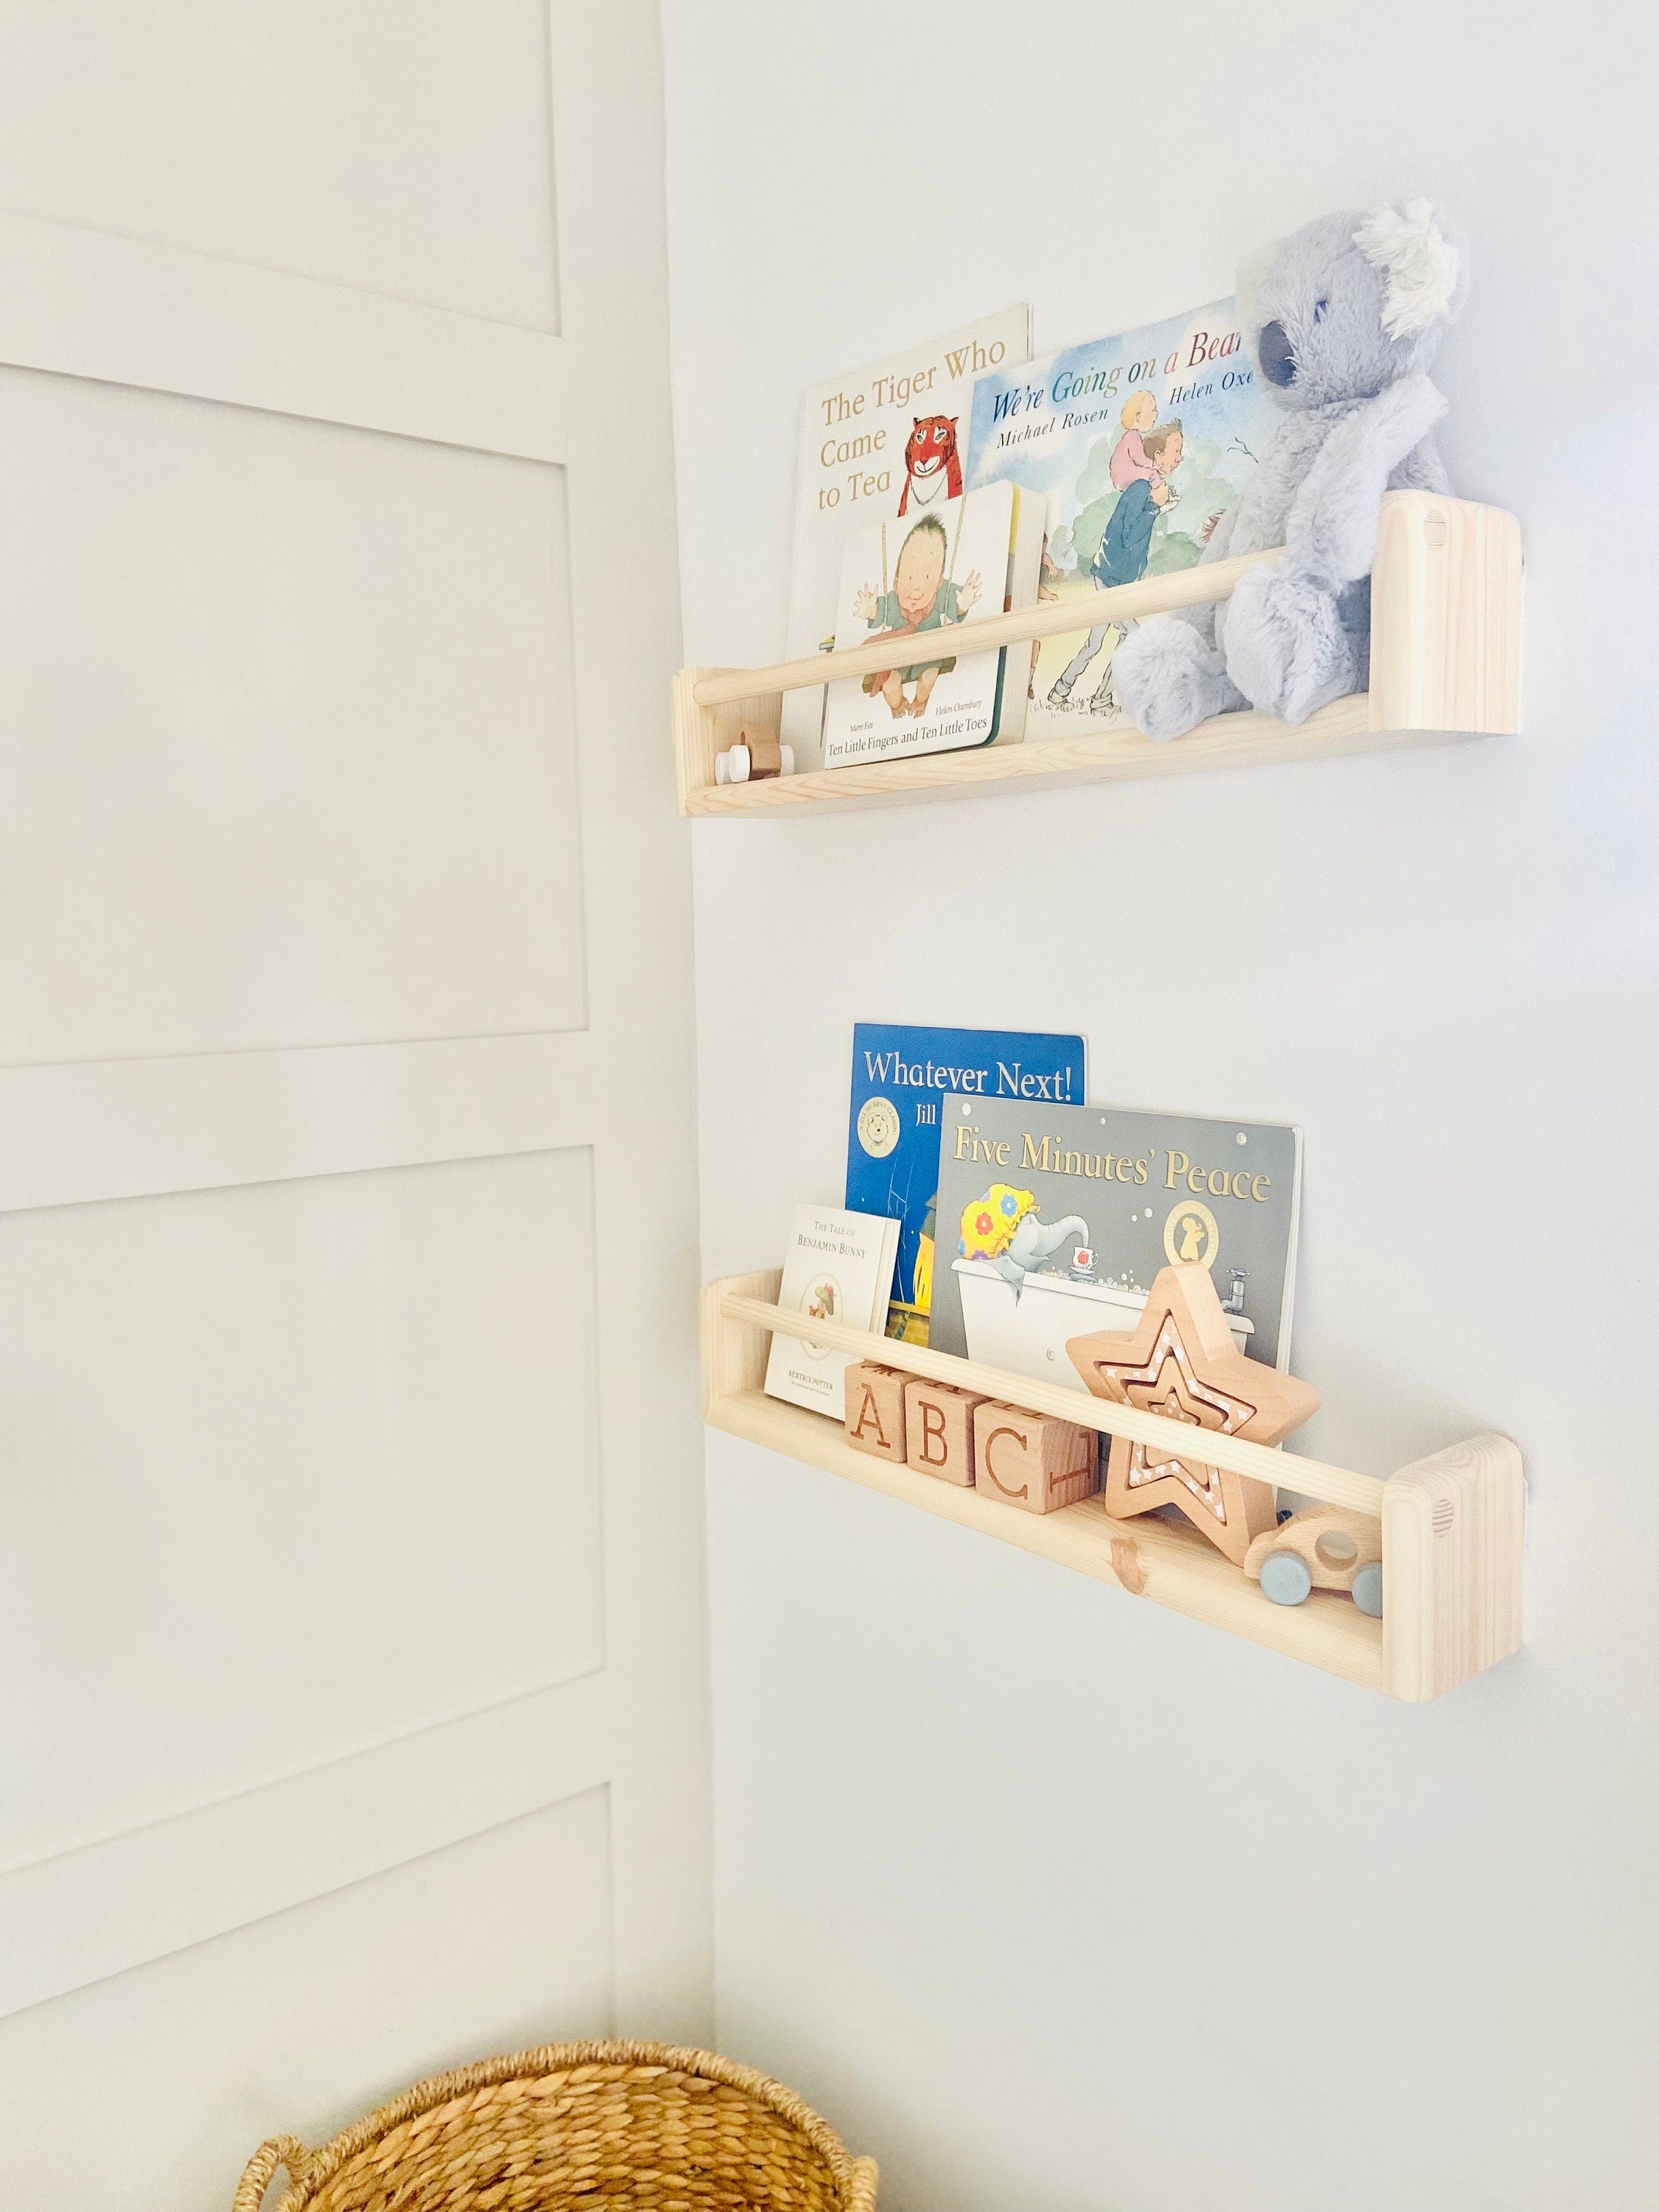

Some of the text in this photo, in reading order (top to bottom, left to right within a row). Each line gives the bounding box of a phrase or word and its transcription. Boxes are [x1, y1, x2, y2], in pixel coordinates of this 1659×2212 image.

[821, 340, 1006, 426] The Tiger Who
[993, 385, 1044, 423] We're
[1051, 366, 1124, 403] Going
[1128, 358, 1156, 383] on
[1164, 352, 1179, 375] a
[1168, 382, 1213, 405] Helen
[997, 408, 1108, 449] Michael Rosen
[820, 429, 886, 468] Came
[818, 470, 891, 510] to Tea
[864, 721, 874, 731] Fox
[935, 699, 982, 716] Helen Oxenbury
[828, 717, 987, 757] Ten Little Fingers and Ten Little Toes
[863, 1050, 1072, 1102] Whatever Next!
[915, 1103, 936, 1127] Jill
[953, 1124, 1272, 1203] Five Minutes' Peace
[797, 1234, 866, 1259] BENJAMIN BUNNY
[814, 1220, 828, 1232] THE
[830, 1223, 846, 1235] TALE
[788, 1369, 812, 1384] BEATRIX
[812, 1377, 833, 1391] POTTER
[850, 1382, 1028, 1500] A B C
